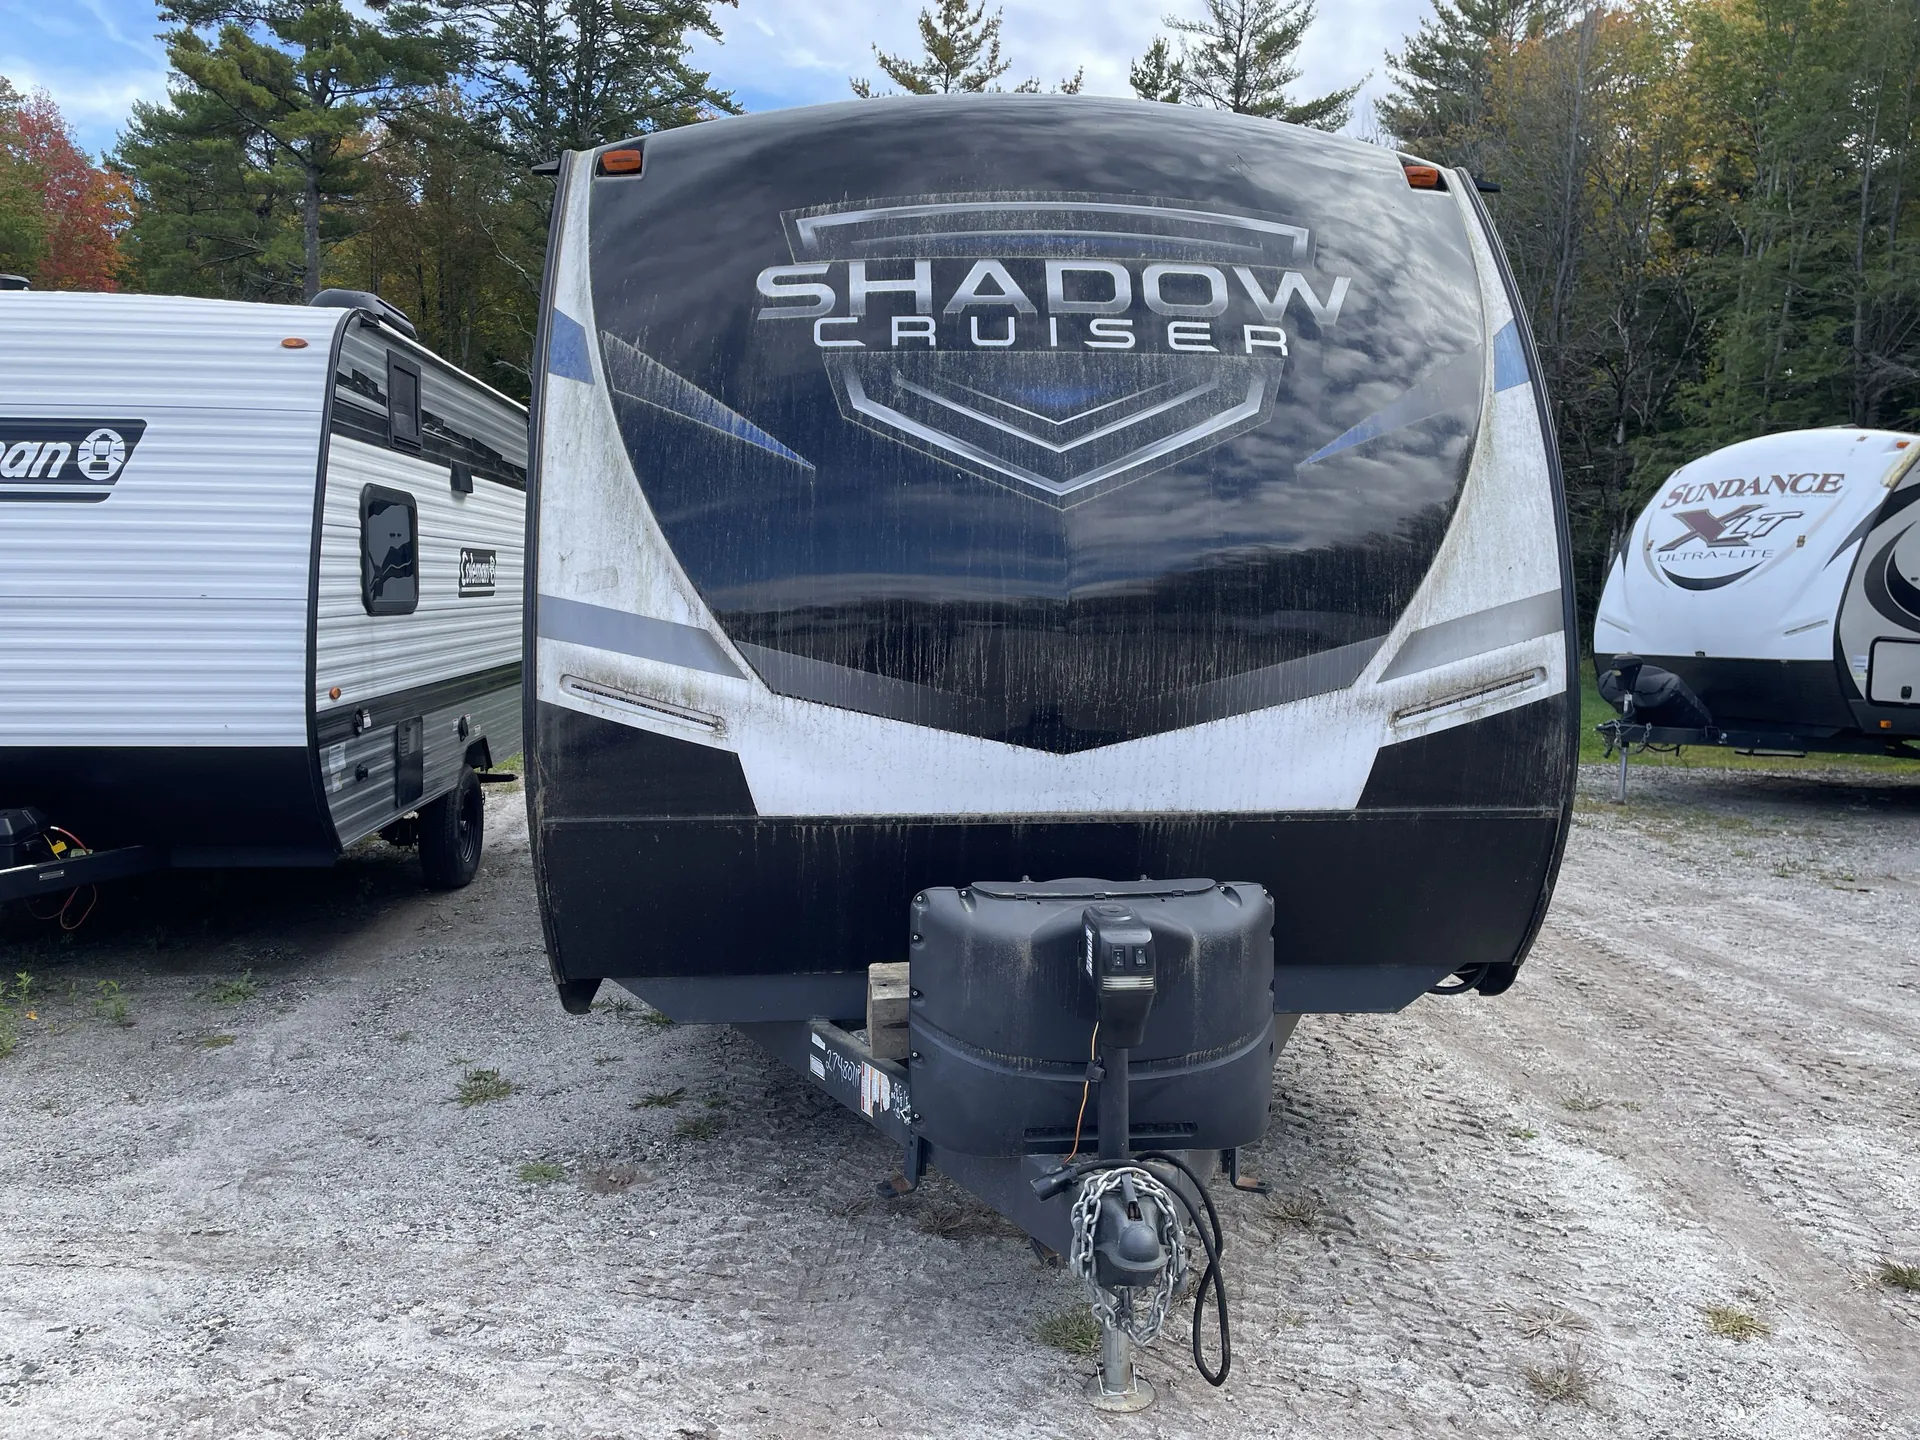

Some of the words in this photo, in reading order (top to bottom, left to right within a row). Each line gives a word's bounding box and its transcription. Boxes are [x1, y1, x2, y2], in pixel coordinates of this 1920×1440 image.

[756, 259, 1352, 324] SHADOW
[813, 315, 1289, 357] CRUISER
[1660, 472, 1845, 510] SUNDANCE
[1657, 503, 1806, 552] XLT
[460, 551, 490, 586] Coleman
[1657, 549, 1775, 563] ULTRA-LITE
